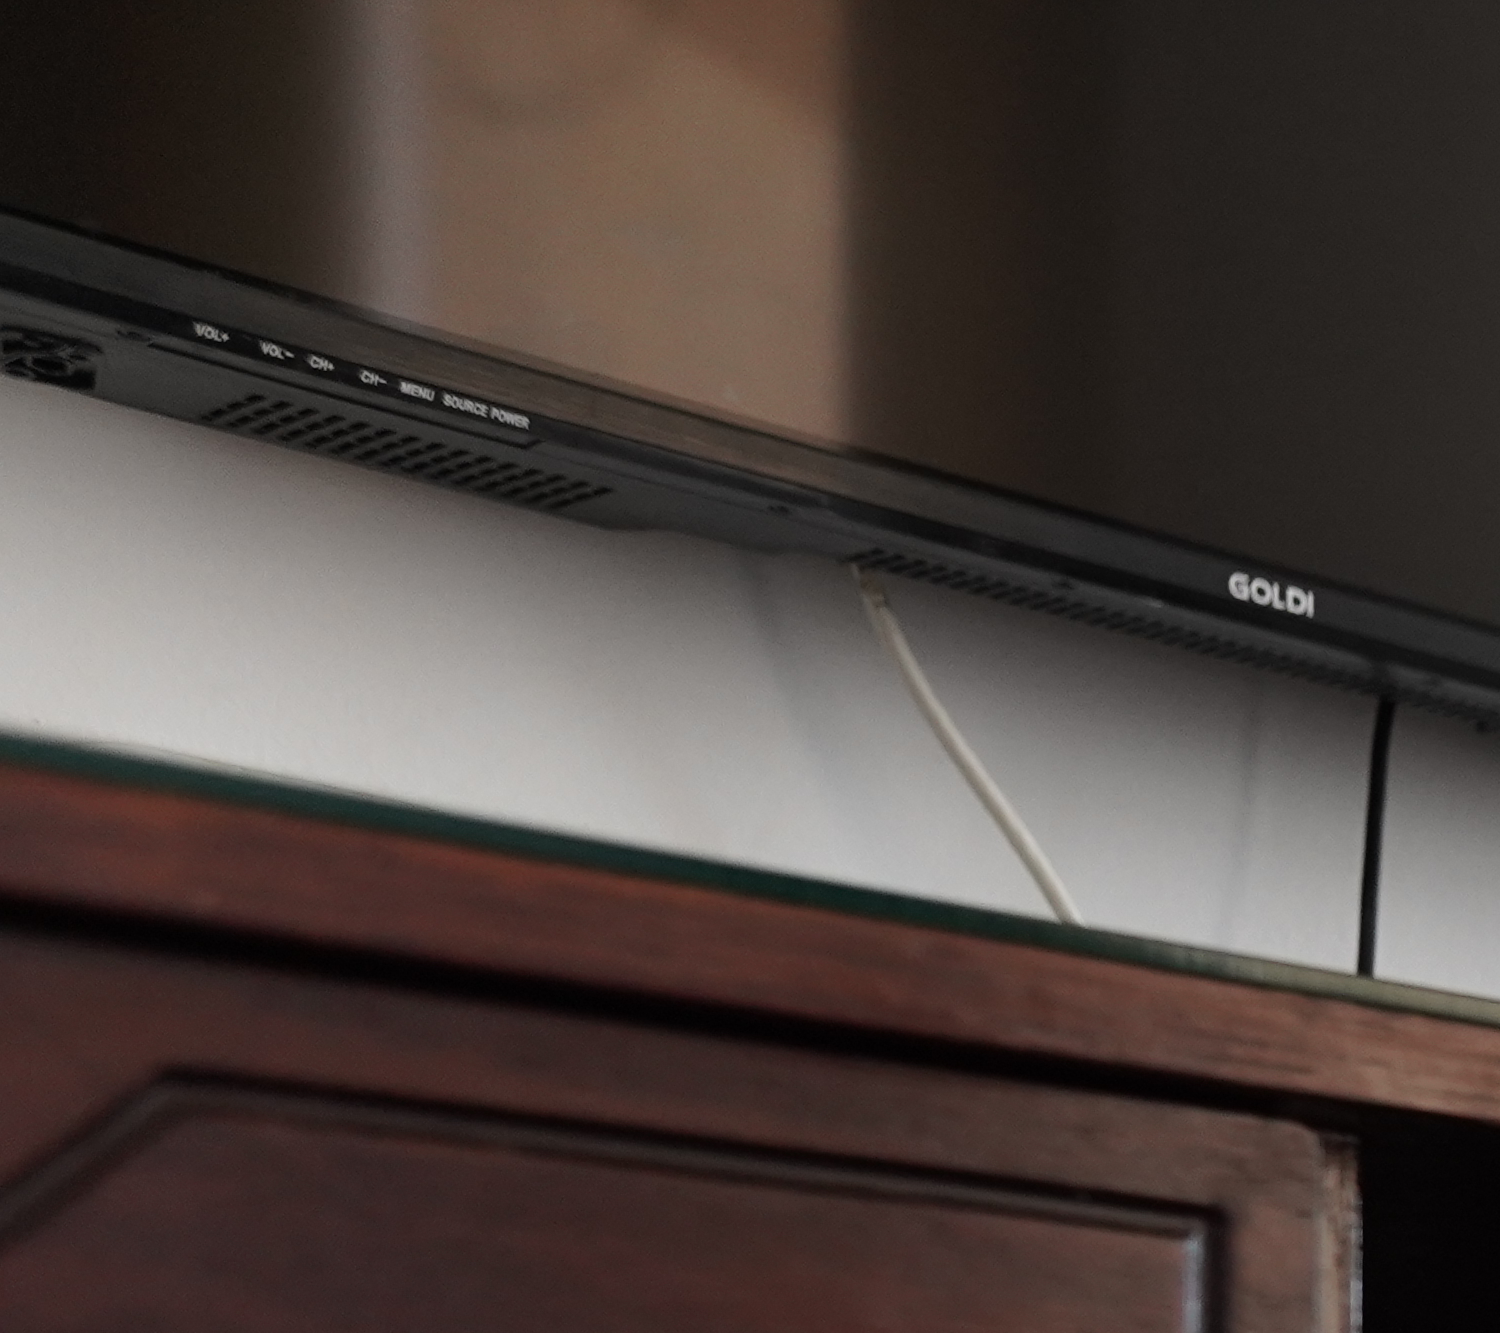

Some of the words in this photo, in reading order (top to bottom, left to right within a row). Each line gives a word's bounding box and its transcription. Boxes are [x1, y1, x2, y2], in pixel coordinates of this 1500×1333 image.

[193, 321, 230, 342] VOL+
[259, 339, 294, 360] VOL-
[307, 354, 335, 371] CH+
[359, 369, 387, 386] CH-
[400, 381, 435, 401] MENU
[442, 391, 489, 418] SOURCE
[489, 405, 531, 430] POWER
[1228, 571, 1315, 619] GOLDI
